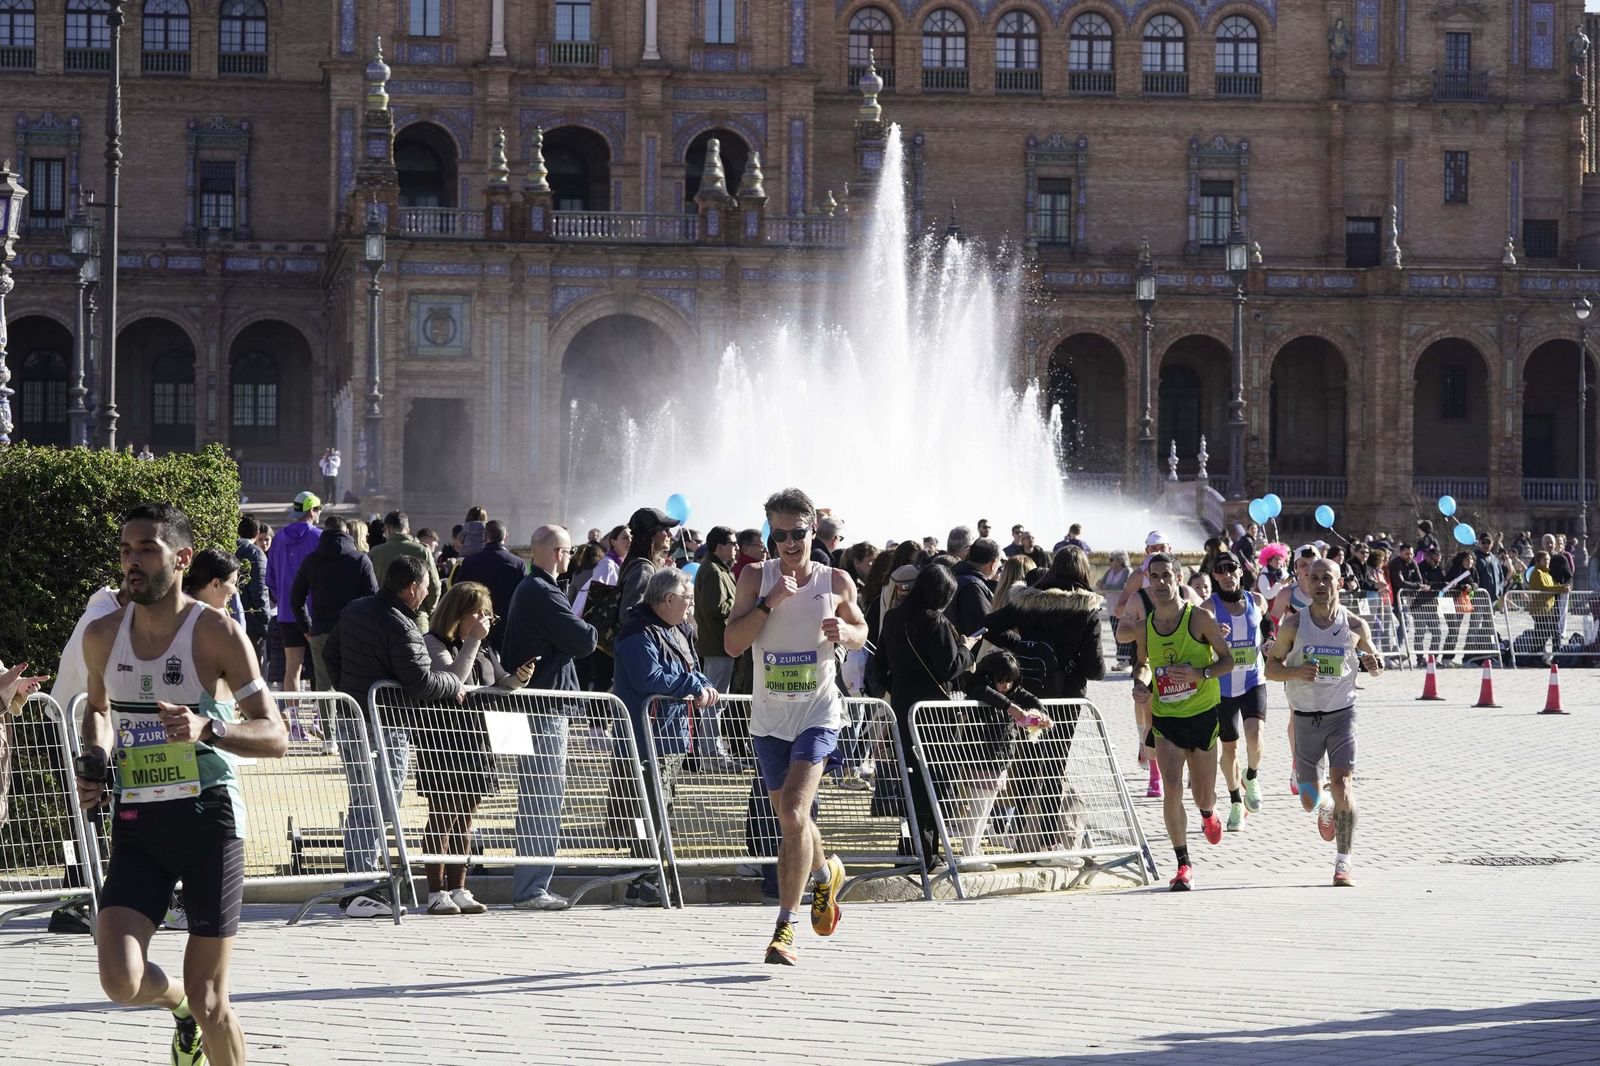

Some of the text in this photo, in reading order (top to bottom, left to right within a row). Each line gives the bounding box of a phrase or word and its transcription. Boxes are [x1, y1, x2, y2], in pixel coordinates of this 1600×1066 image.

[1317, 647, 1340, 655] ZURICH
[780, 655, 811, 664] ZURICH
[765, 681, 817, 690] JOHN DENNIS
[138, 730, 168, 743] ZURI
[143, 753, 167, 764] 1730
[132, 766, 186, 785] MIGUEL
